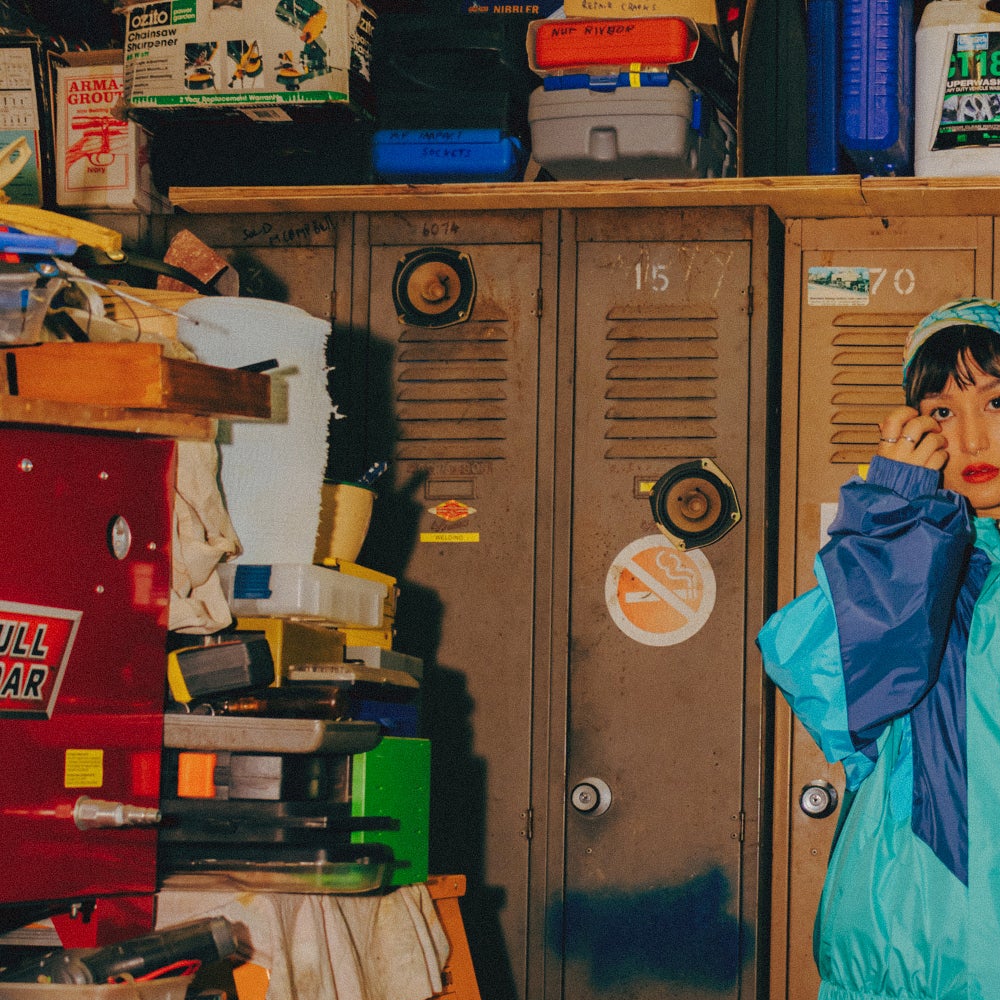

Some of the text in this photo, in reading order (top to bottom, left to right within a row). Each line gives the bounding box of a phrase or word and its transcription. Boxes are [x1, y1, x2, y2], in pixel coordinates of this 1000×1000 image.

[131, 9, 169, 28] ozito
[127, 38, 178, 52] Sharpener
[128, 28, 177, 42] Chainsaw
[69, 79, 124, 92] ARMA-
[635, 262, 669, 291] 15
[868, 268, 916, 295] 70
[0, 620, 49, 660] ULL
[0, 661, 49, 700] AR
